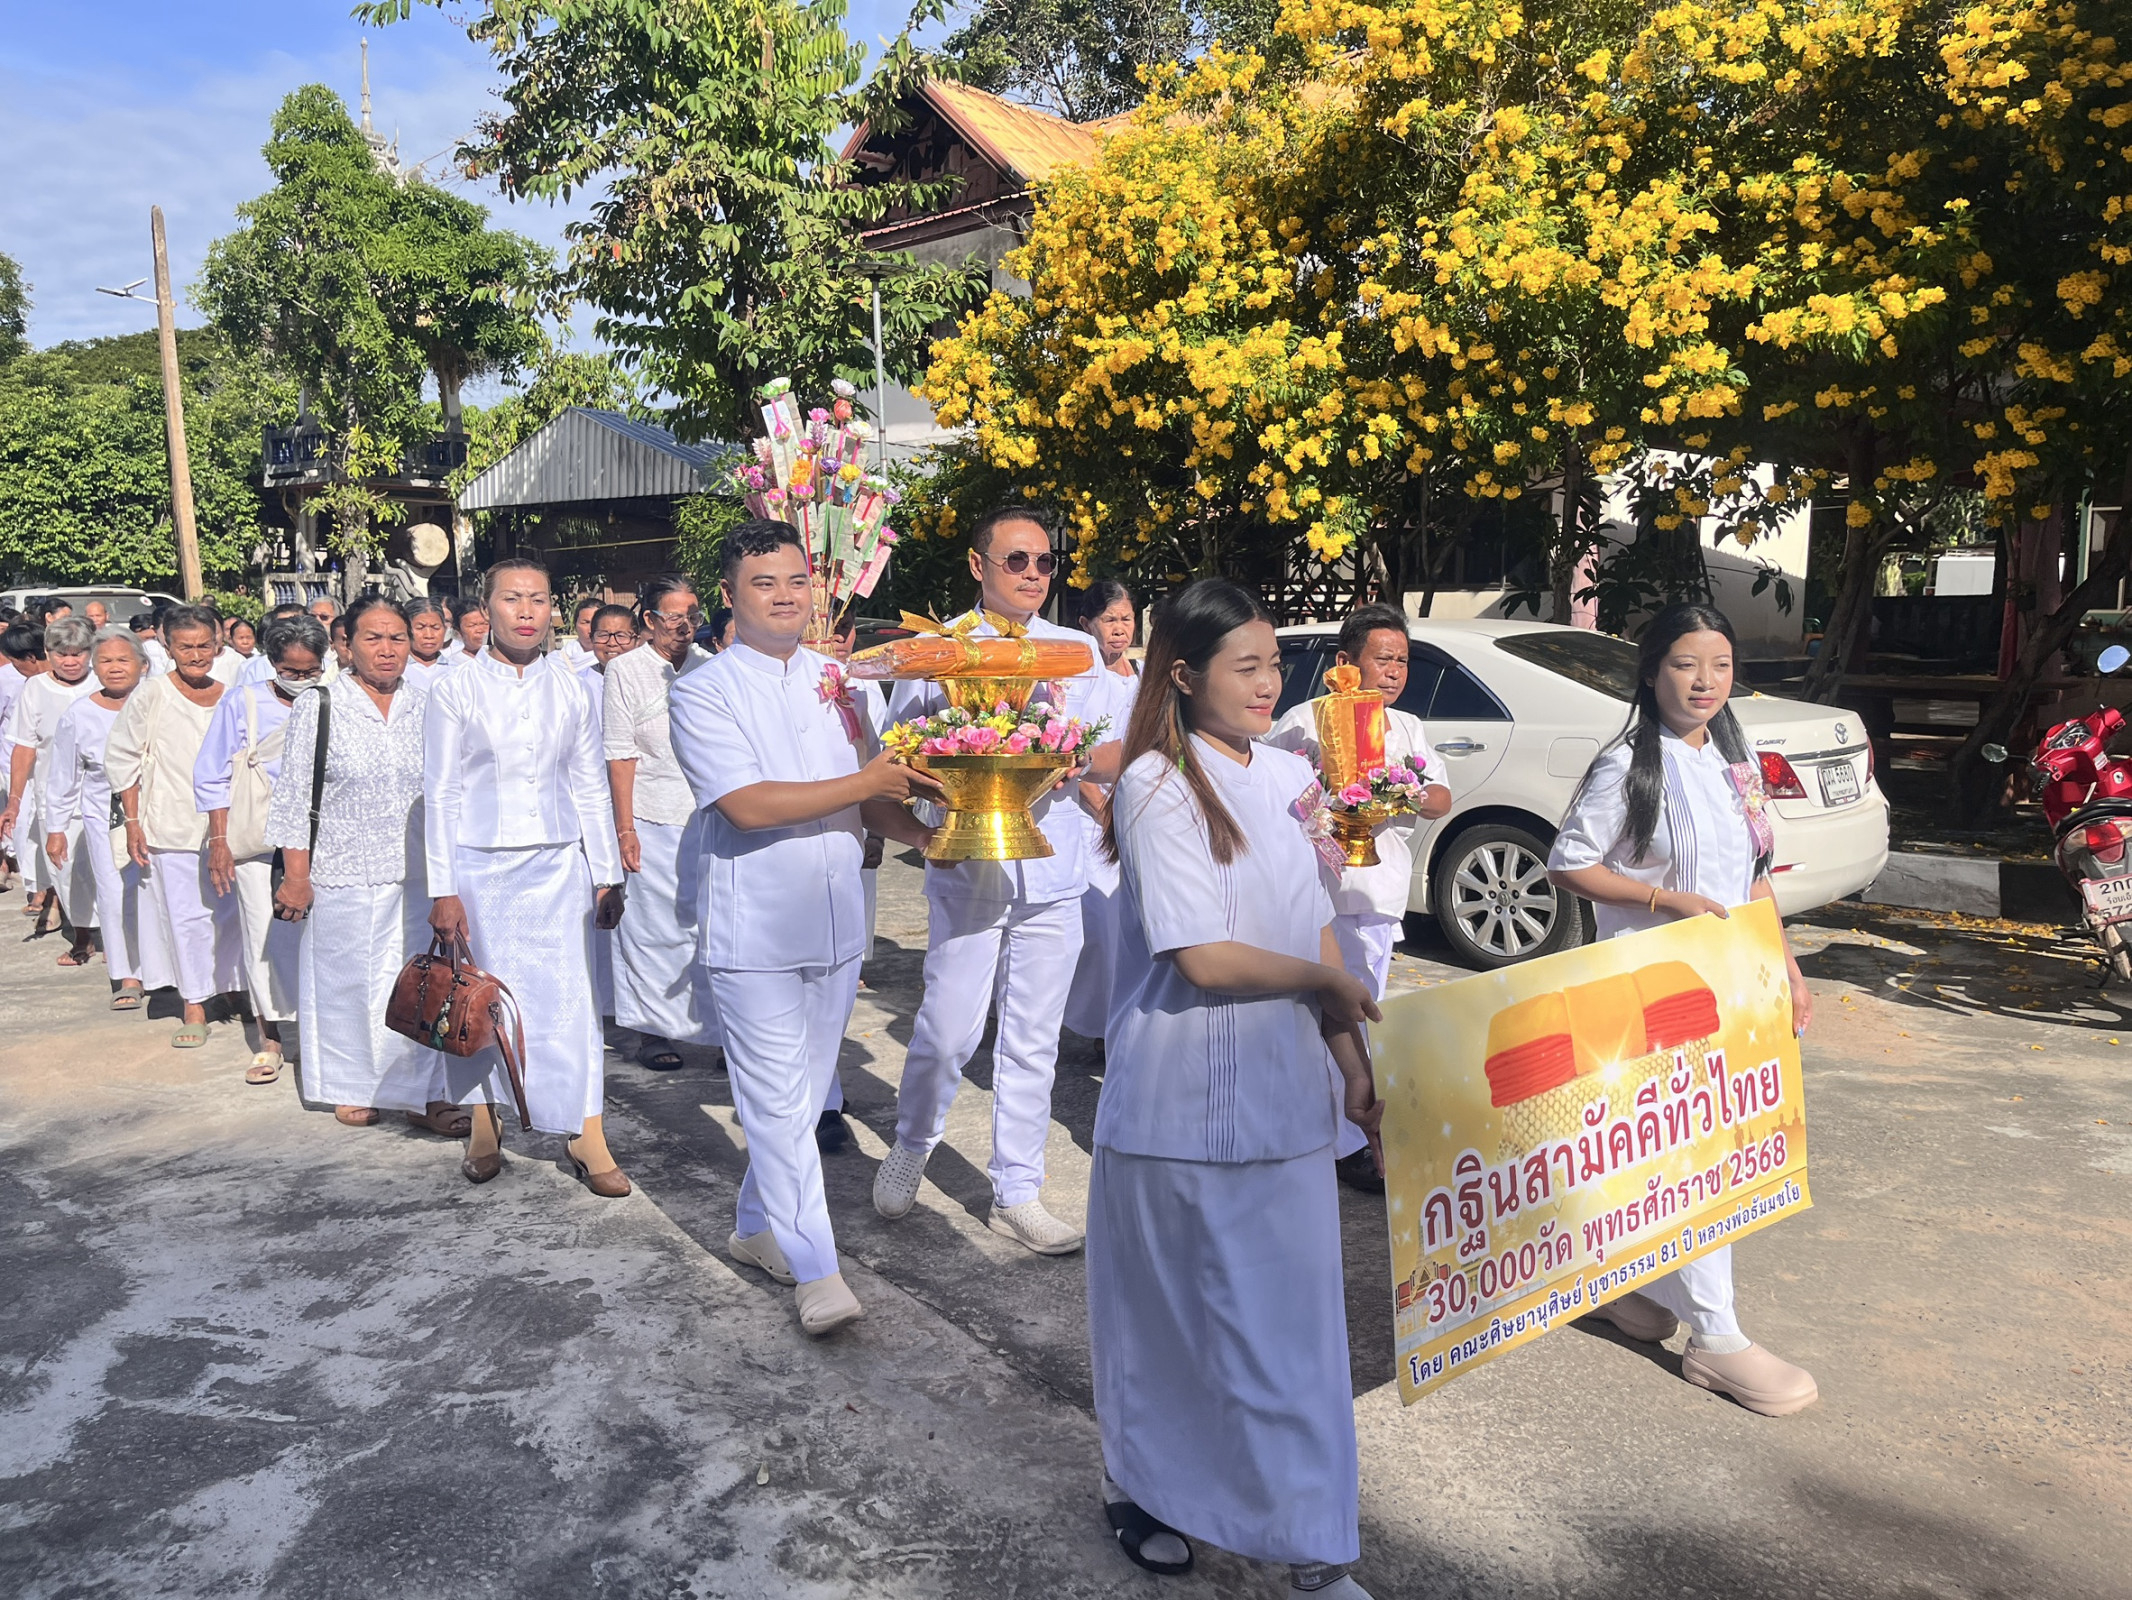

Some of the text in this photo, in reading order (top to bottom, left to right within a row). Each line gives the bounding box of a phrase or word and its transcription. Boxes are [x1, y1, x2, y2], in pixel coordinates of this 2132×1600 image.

[1424, 1054, 1780, 1257] กฐินสามัคคีทั่วไทย
[1428, 1134, 1786, 1322] 30,000วัด พุทธศักราช 2568
[1410, 1354, 1442, 1384] โดย
[1450, 1277, 1582, 1364] คณะศิษยานุศิษย์
[1588, 1251, 1655, 1304] บูชาธรรม
[1661, 1240, 1677, 1263] 81
[1683, 1229, 1692, 1252] ปี
